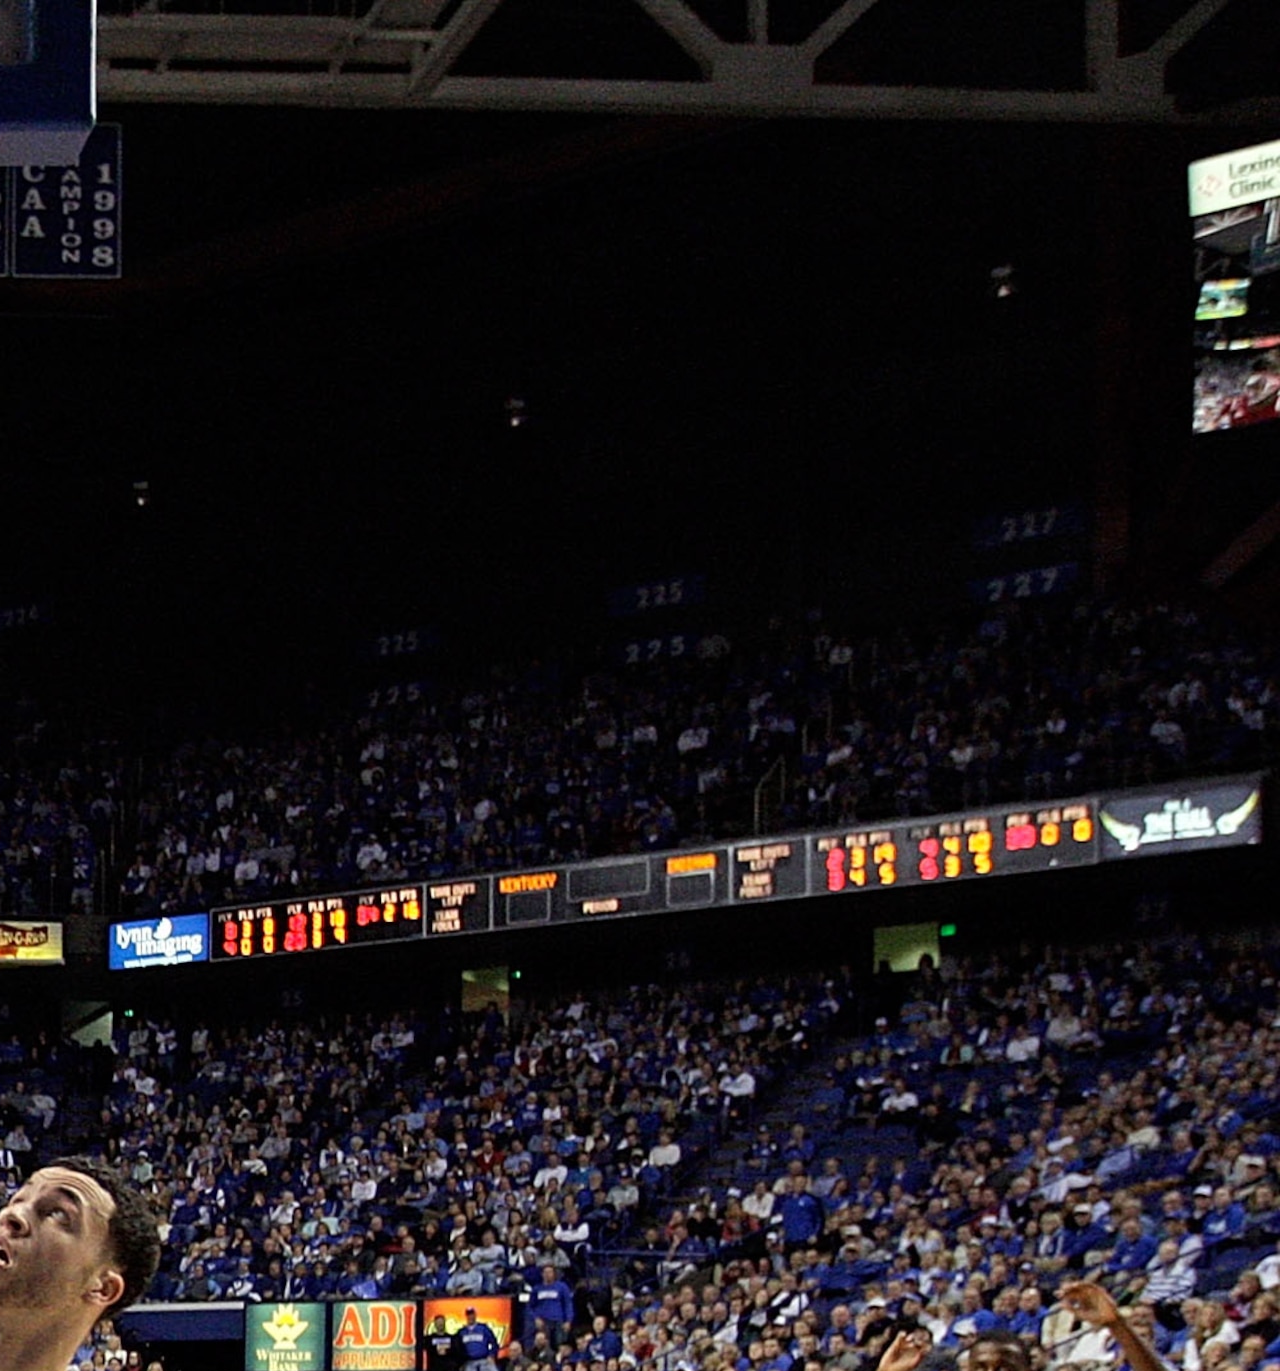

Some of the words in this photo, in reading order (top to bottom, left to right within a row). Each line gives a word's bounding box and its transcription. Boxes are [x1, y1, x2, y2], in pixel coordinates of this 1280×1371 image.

[498, 873, 557, 893] KENTUCKY
[116, 924, 153, 949] lynn
[136, 934, 203, 958] imaging
[334, 1302, 417, 1348] ADI
[256, 1348, 312, 1362] WHITAKER
